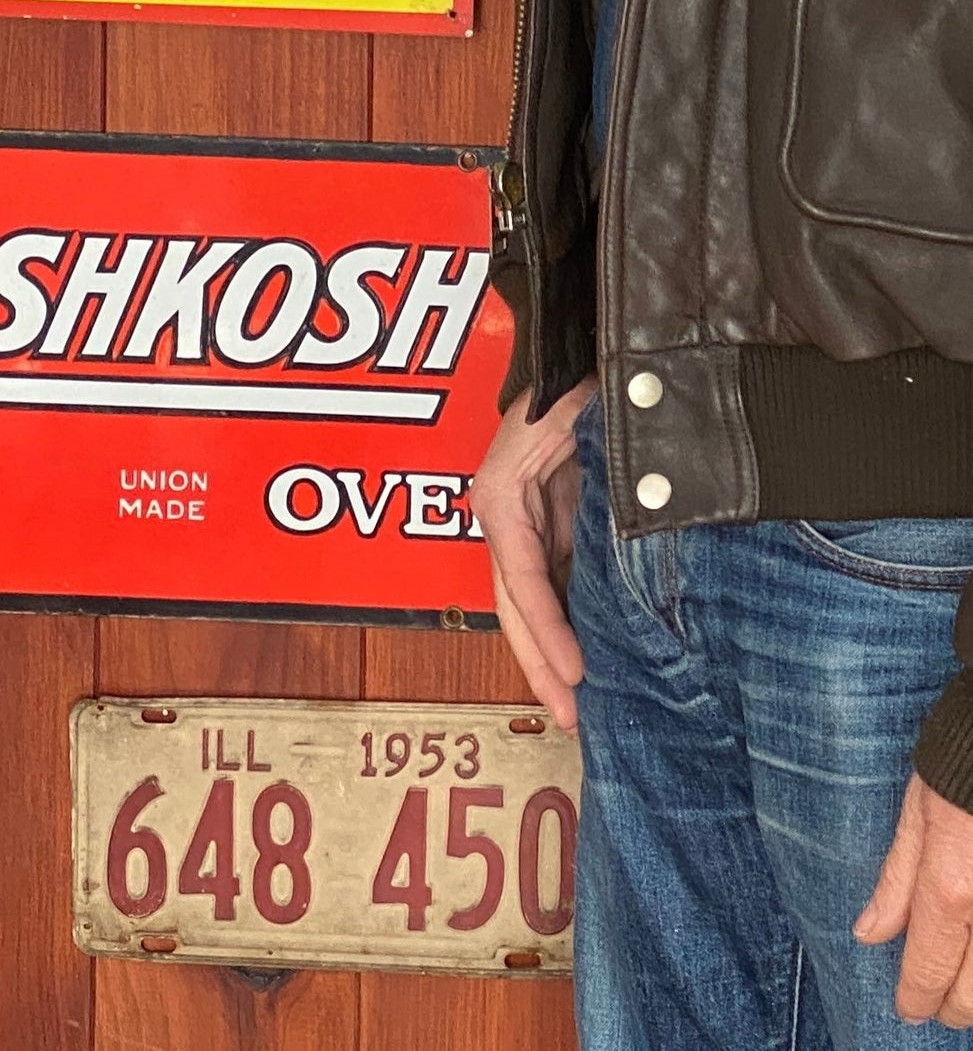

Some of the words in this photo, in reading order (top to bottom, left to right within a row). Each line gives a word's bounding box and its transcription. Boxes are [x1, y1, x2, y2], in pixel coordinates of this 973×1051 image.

[0, 227, 491, 374] SHKOSH
[118, 499, 206, 522] MADE
[120, 469, 208, 492] UNION
[265, 464, 486, 543] OVE
[201, 728, 272, 773] ILL
[361, 731, 481, 780] 1953
[106, 774, 313, 926] 648
[371, 784, 578, 936] 450
